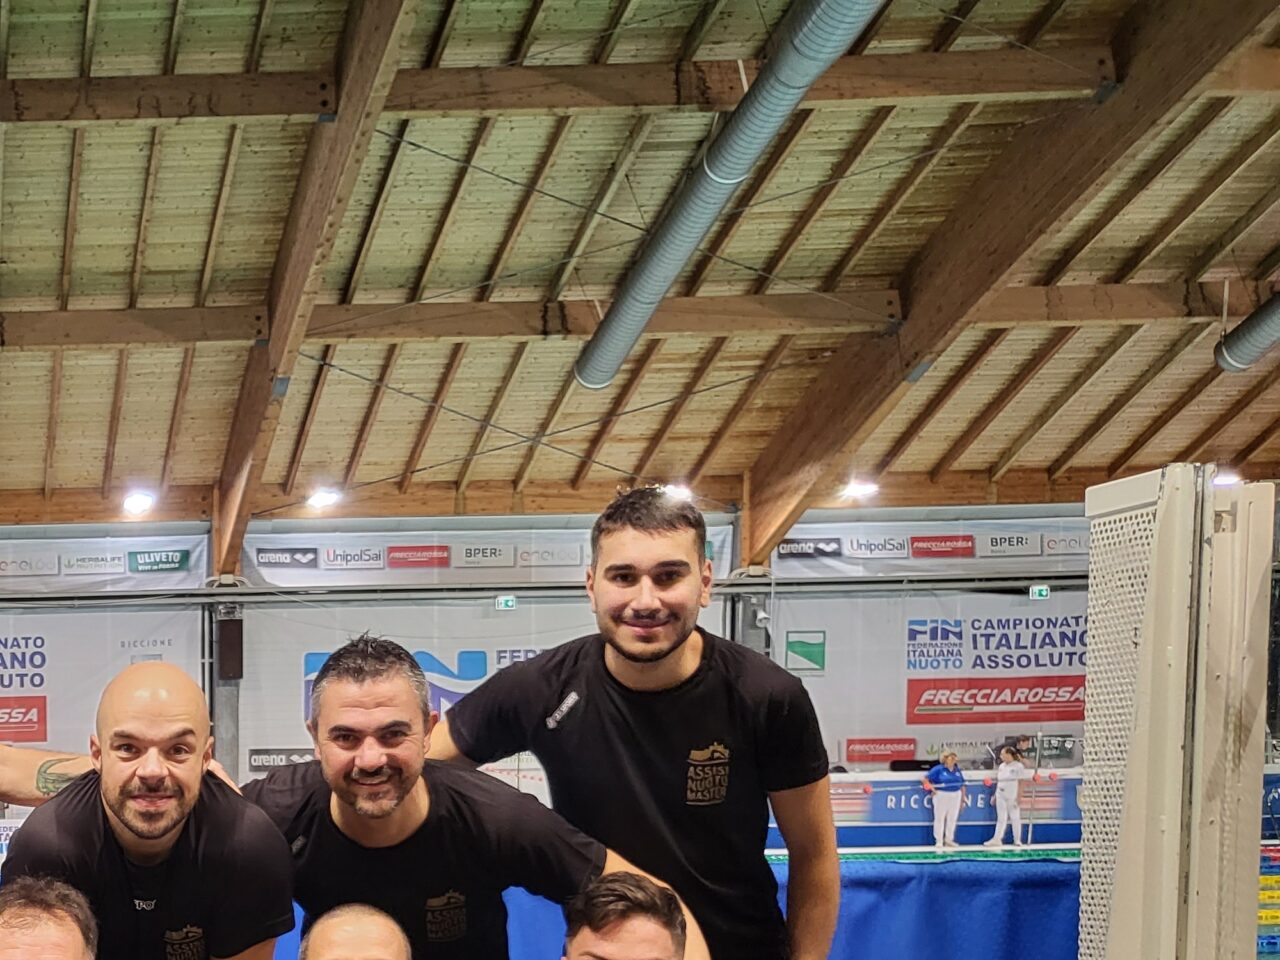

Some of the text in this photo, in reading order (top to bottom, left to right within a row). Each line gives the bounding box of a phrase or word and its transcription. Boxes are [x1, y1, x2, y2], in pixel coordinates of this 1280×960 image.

[779, 542, 815, 553] arena
[850, 538, 906, 554] UnipolSai
[990, 537, 1029, 547] BPER:
[137, 552, 180, 563] ULIVETO
[258, 552, 291, 563] arena
[325, 549, 381, 566] UnipolSai
[388, 551, 448, 559] FRECCIAROSSA
[465, 548, 502, 558] BPER:
[971, 615, 1088, 631] CAMPIONAT
[907, 649, 963, 658] ITALIANA
[907, 658, 963, 670] NUOTO
[919, 686, 1086, 705] FRECCIAROSSA
[848, 743, 915, 752] FRECCIAROSSA
[251, 754, 286, 766] arena
[886, 793, 985, 809] RICCNE
